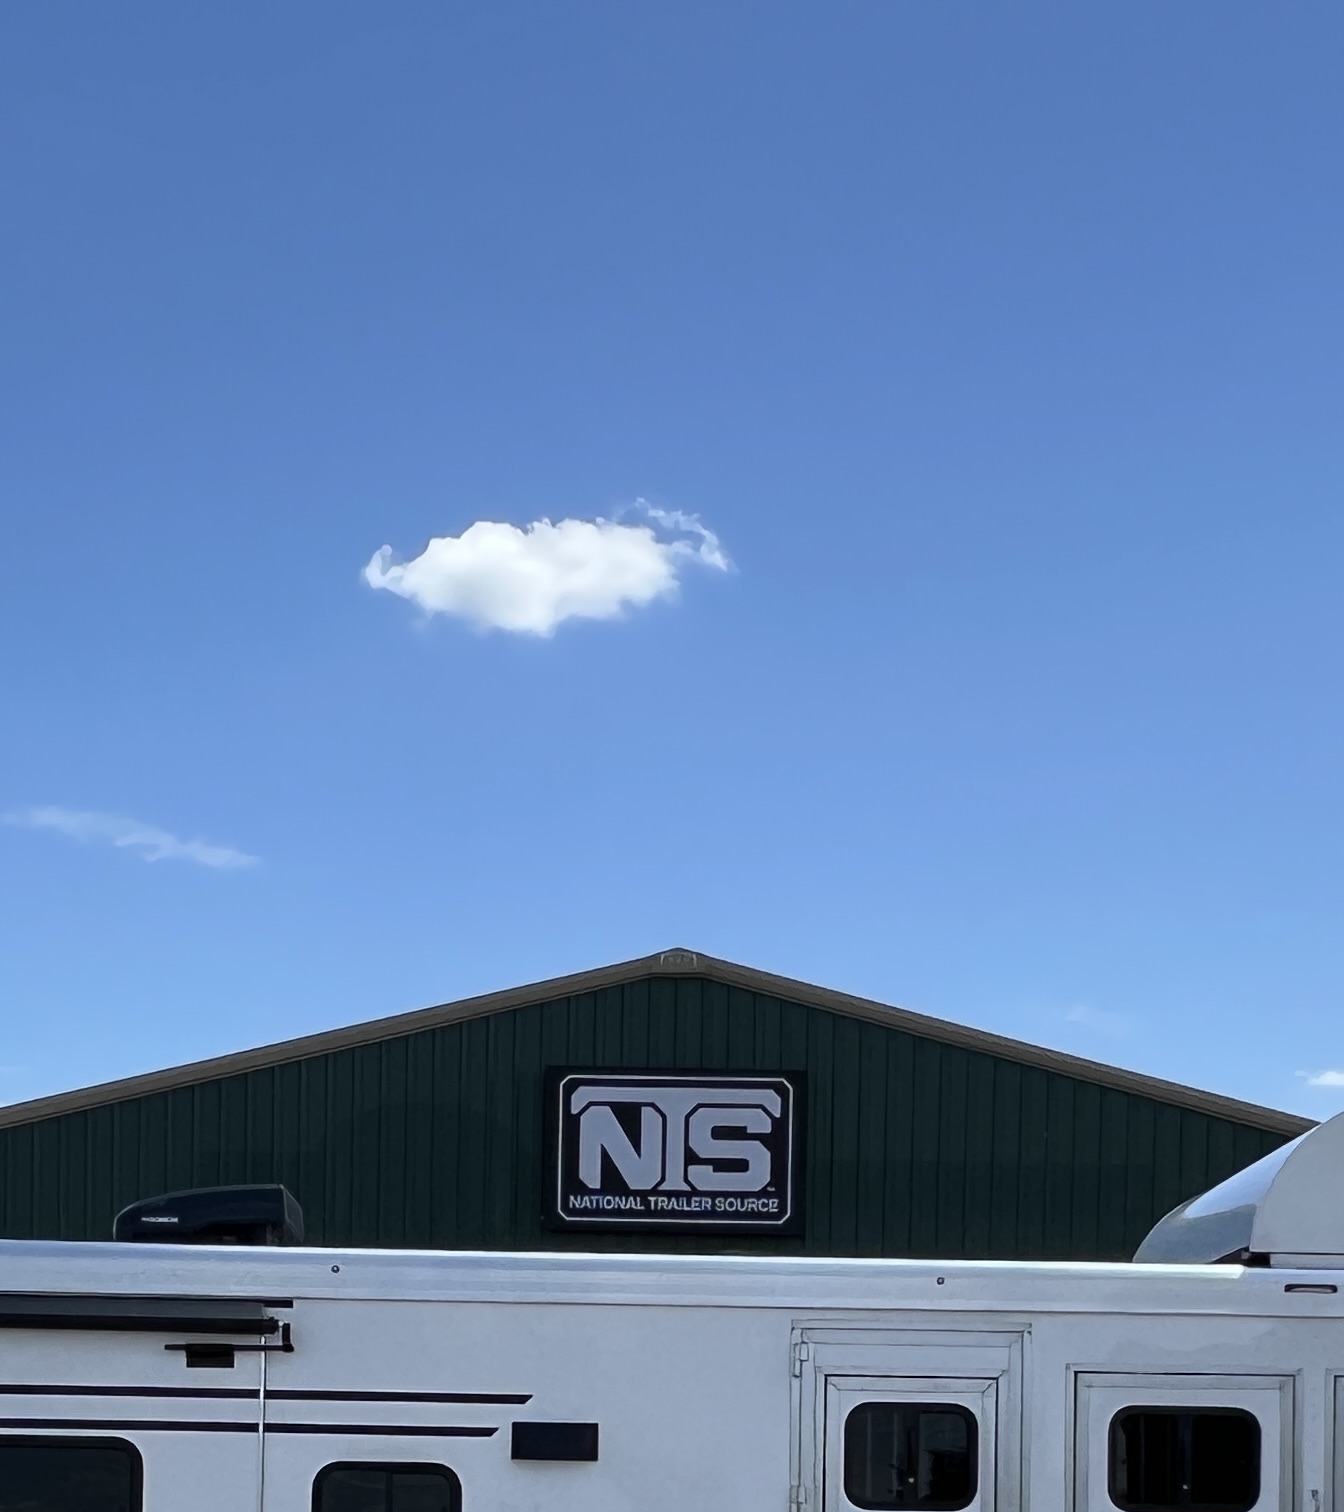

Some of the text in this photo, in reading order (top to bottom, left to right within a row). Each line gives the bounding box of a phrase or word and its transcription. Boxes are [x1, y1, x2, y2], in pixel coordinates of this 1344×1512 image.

[571, 1086, 781, 1191] NTS
[569, 1195, 779, 1212] NATIONAL TRAILER SOURCE
